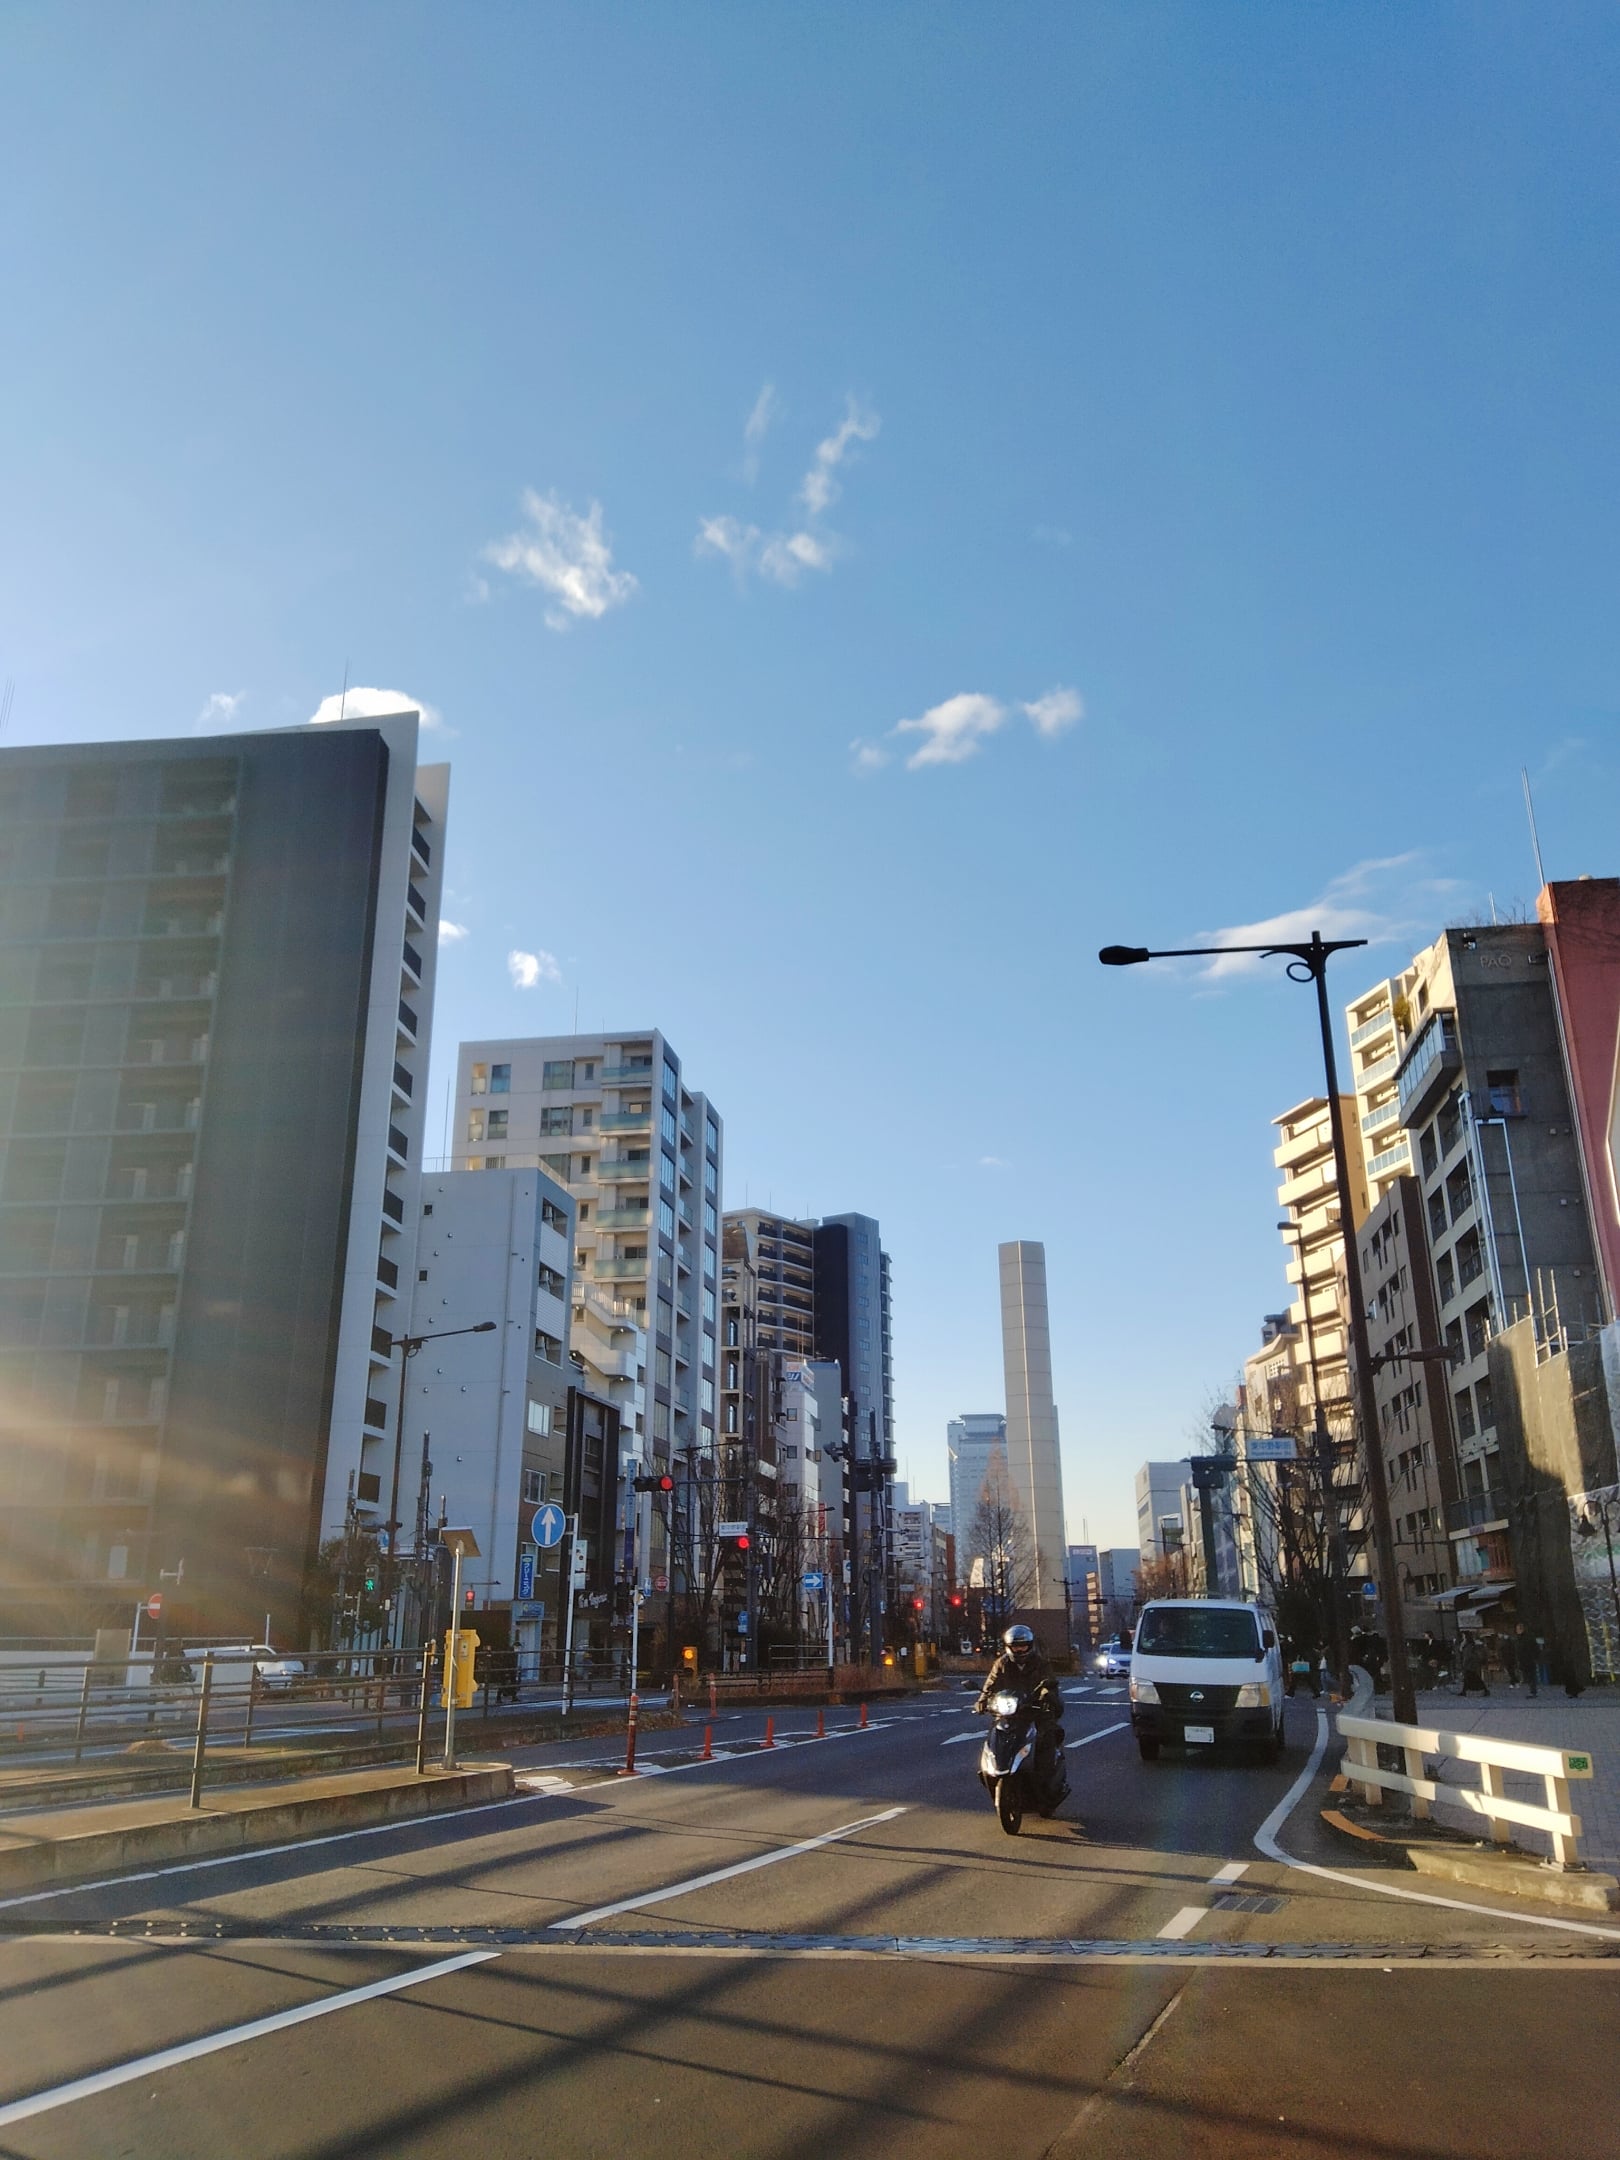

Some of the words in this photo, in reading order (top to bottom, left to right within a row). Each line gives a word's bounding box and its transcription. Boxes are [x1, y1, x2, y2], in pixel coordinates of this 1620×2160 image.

[521, 1562, 530, 1595] クリーニング
